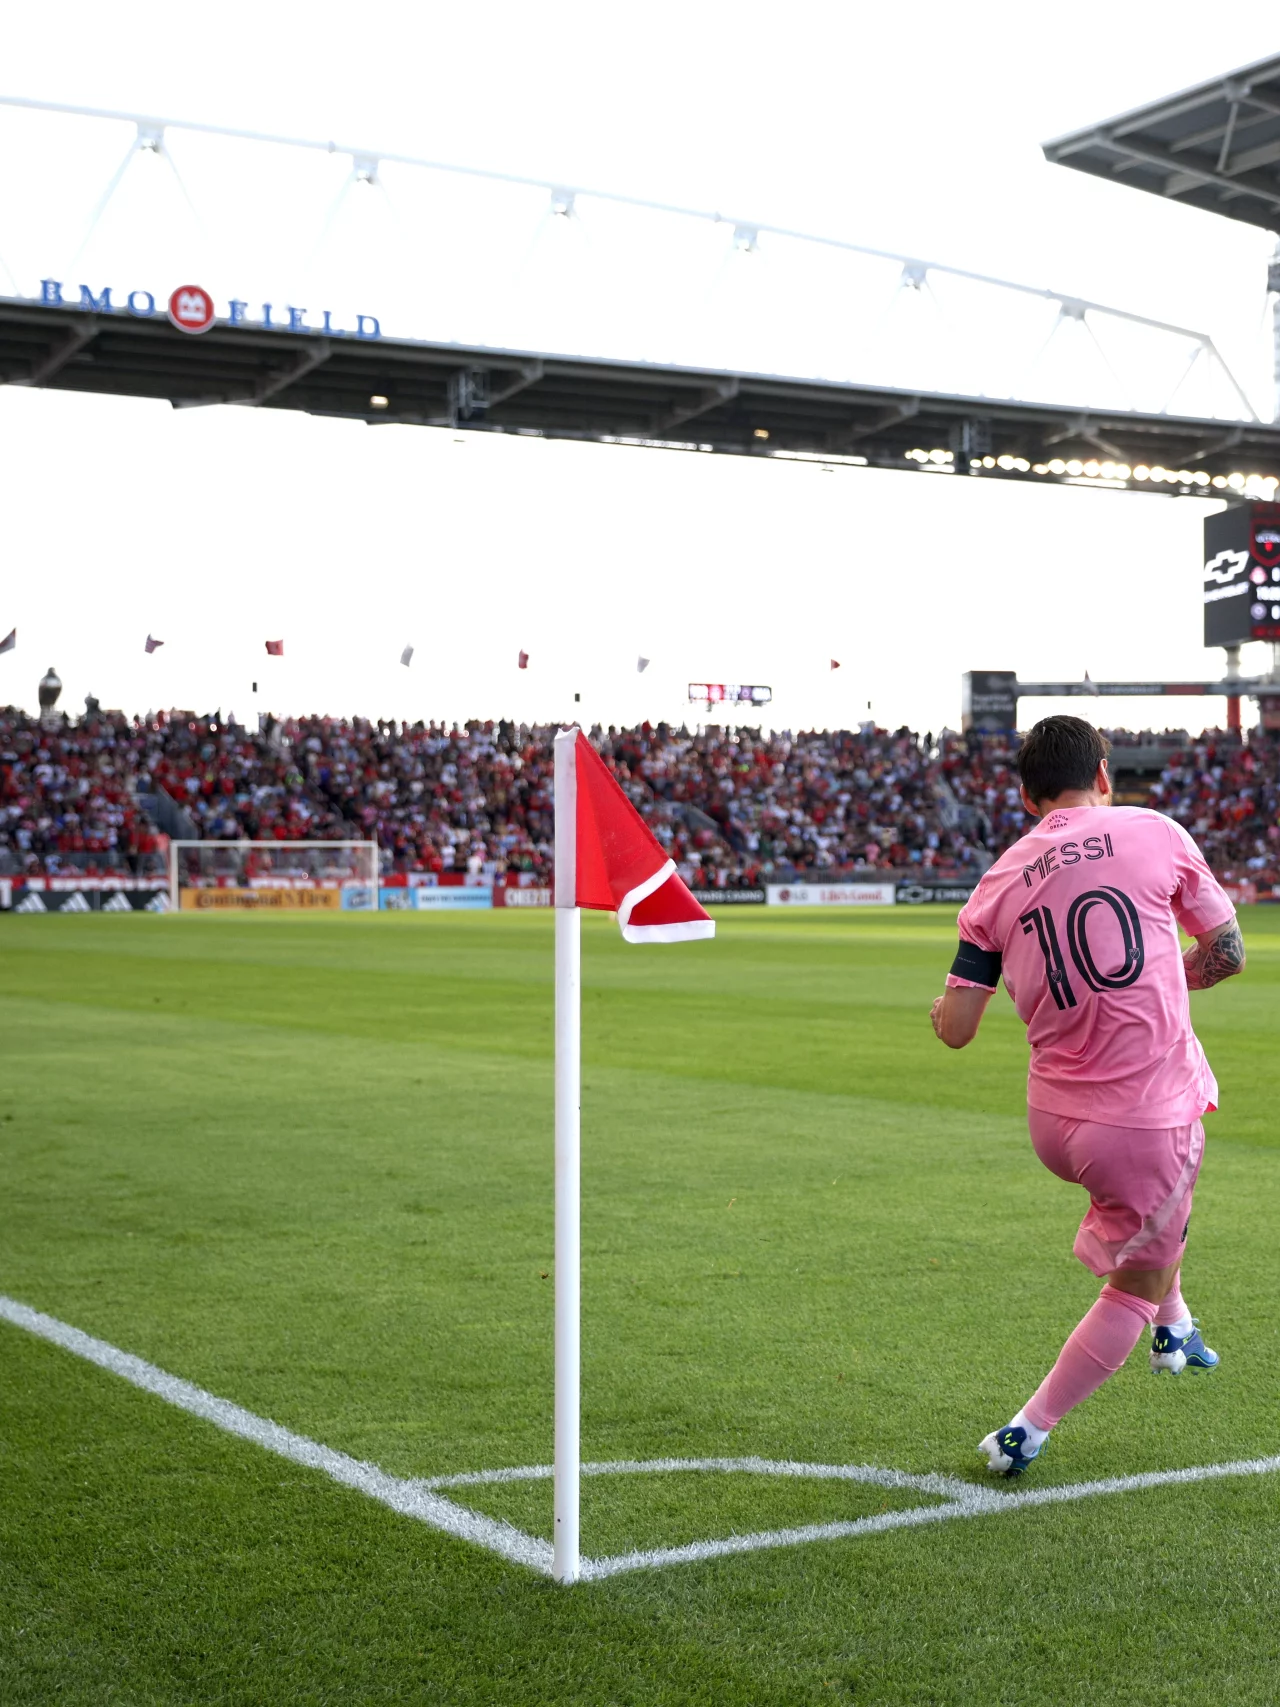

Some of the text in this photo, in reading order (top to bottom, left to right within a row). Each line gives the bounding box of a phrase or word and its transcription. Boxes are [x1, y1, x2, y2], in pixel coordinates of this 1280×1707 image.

[39, 278, 382, 340] BMO FIELD
[1022, 833, 1114, 888] MESSI
[1018, 885, 1145, 1011] 10
